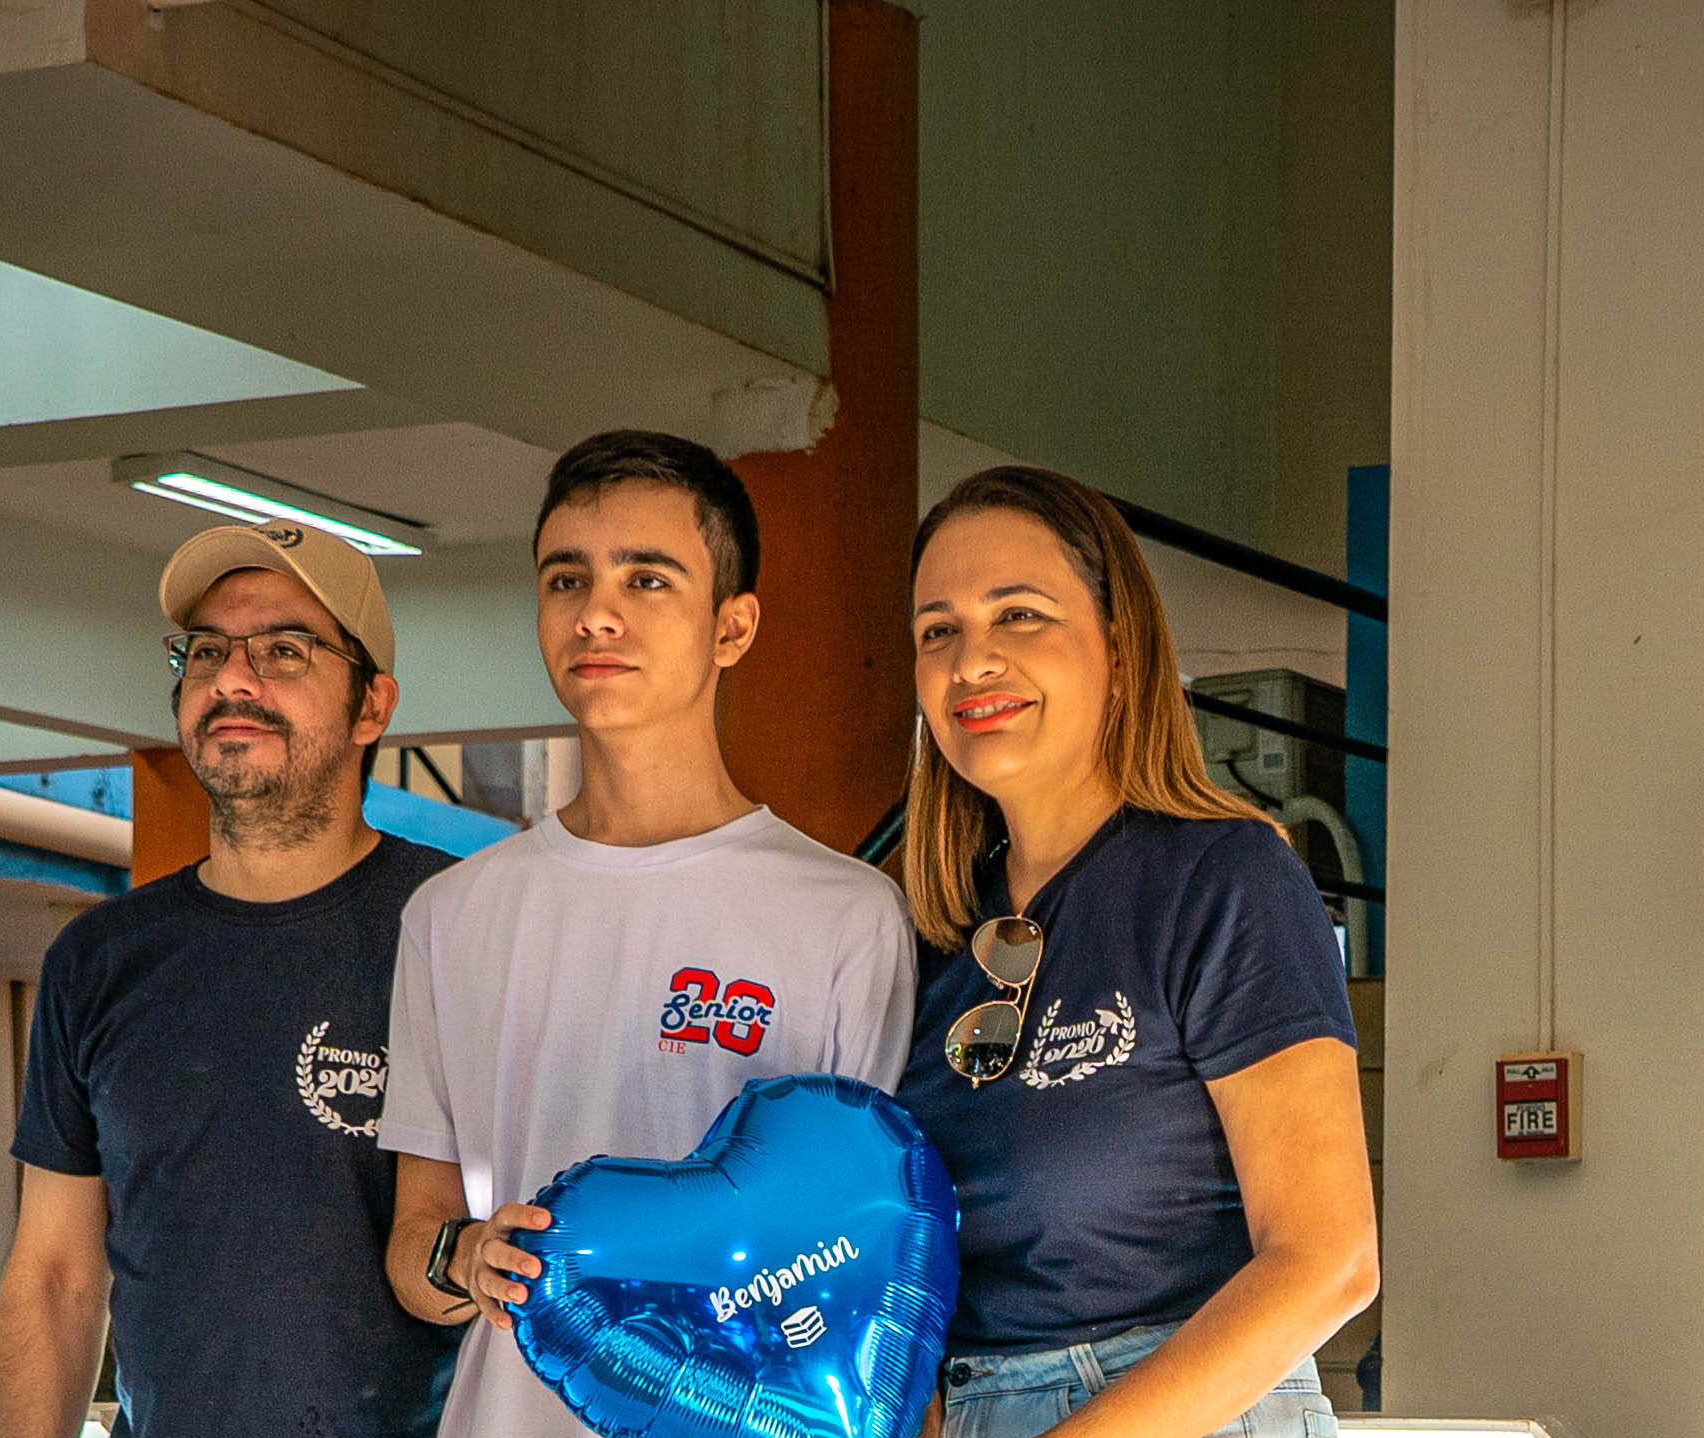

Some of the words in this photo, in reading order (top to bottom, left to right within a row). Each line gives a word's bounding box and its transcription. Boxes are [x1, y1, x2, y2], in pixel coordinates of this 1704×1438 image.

[660, 993, 773, 1031] Senior
[1050, 1020, 1096, 1042] PROMO
[317, 1046, 381, 1069] PROMO
[658, 1040, 687, 1055] CIE
[1507, 1110, 1554, 1131] FIRE
[709, 1236, 860, 1323] Benjamin
